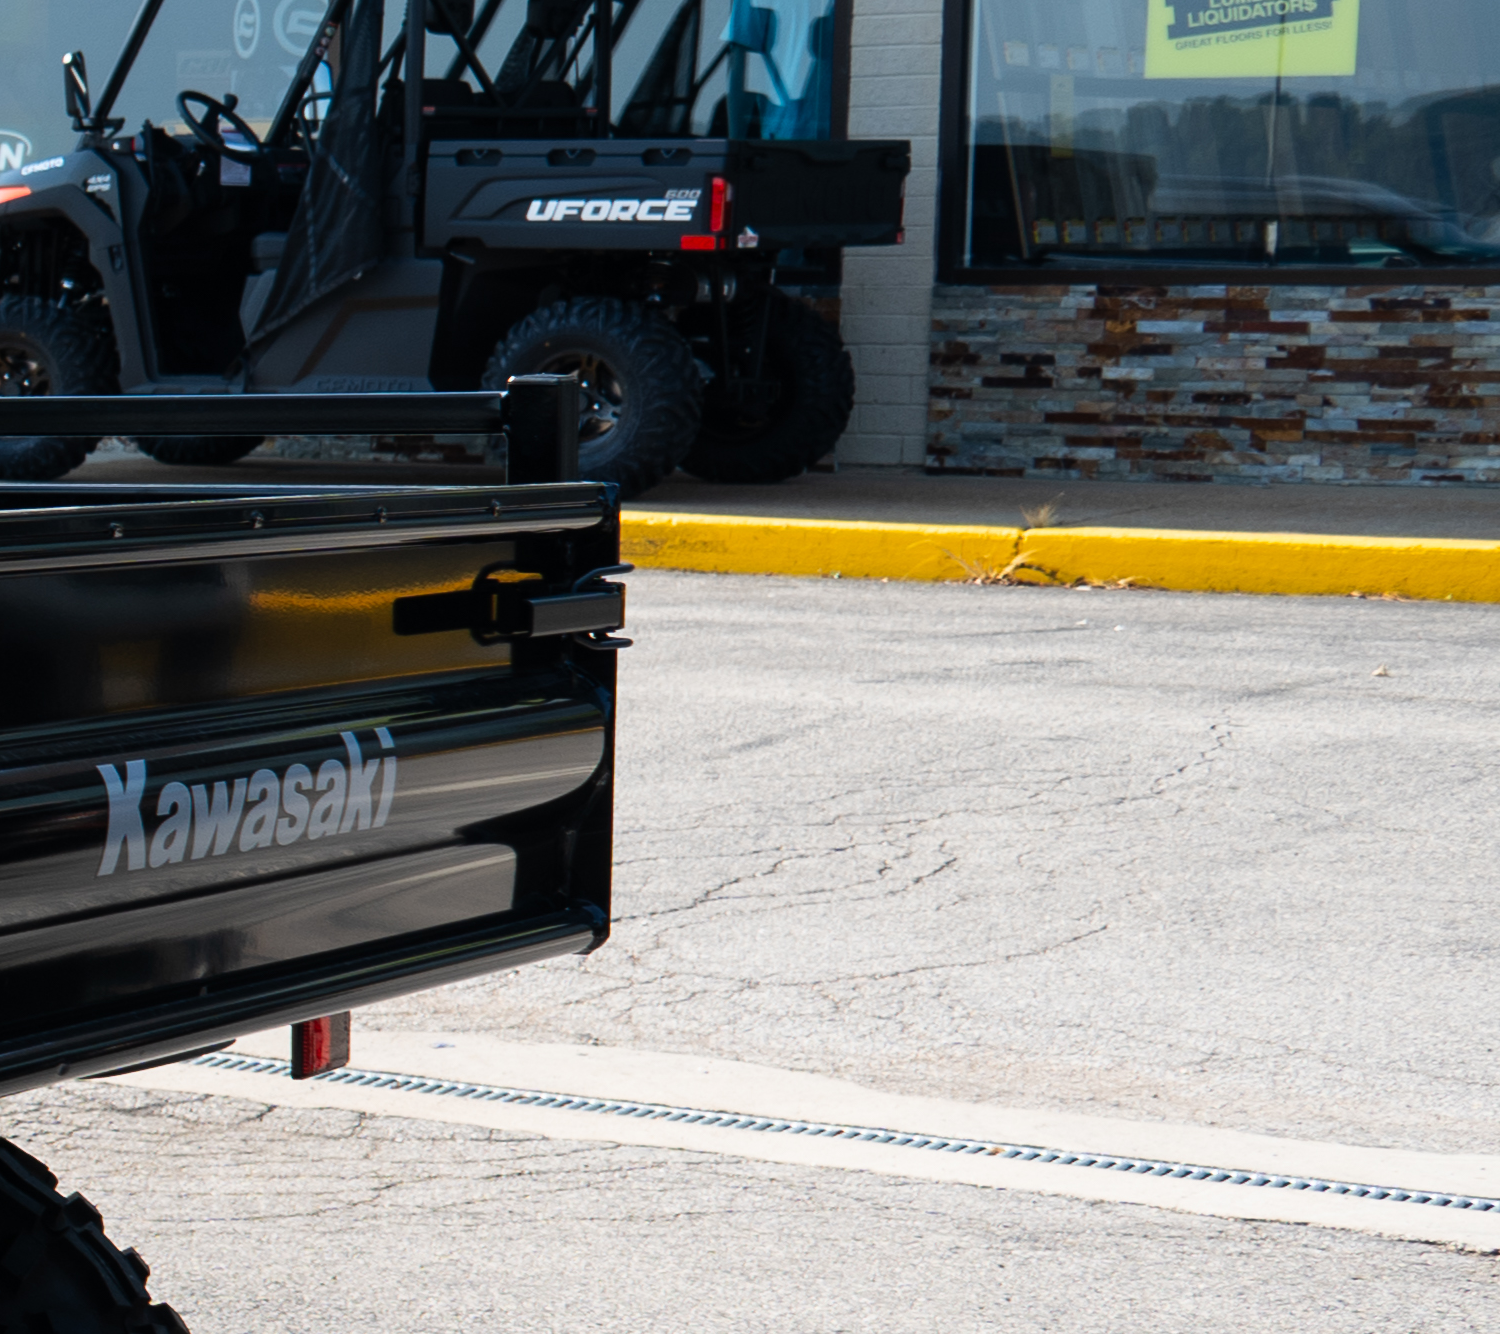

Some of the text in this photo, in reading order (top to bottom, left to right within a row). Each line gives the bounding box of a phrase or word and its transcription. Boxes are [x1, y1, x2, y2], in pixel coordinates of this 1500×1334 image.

[1175, 37, 1213, 51] GREAT
[1216, 30, 1263, 46] FLOORS
[1266, 27, 1291, 38] FOR
[664, 188, 702, 200] 600
[526, 198, 698, 222] UFORCE
[96, 726, 398, 877] Kawasaki
